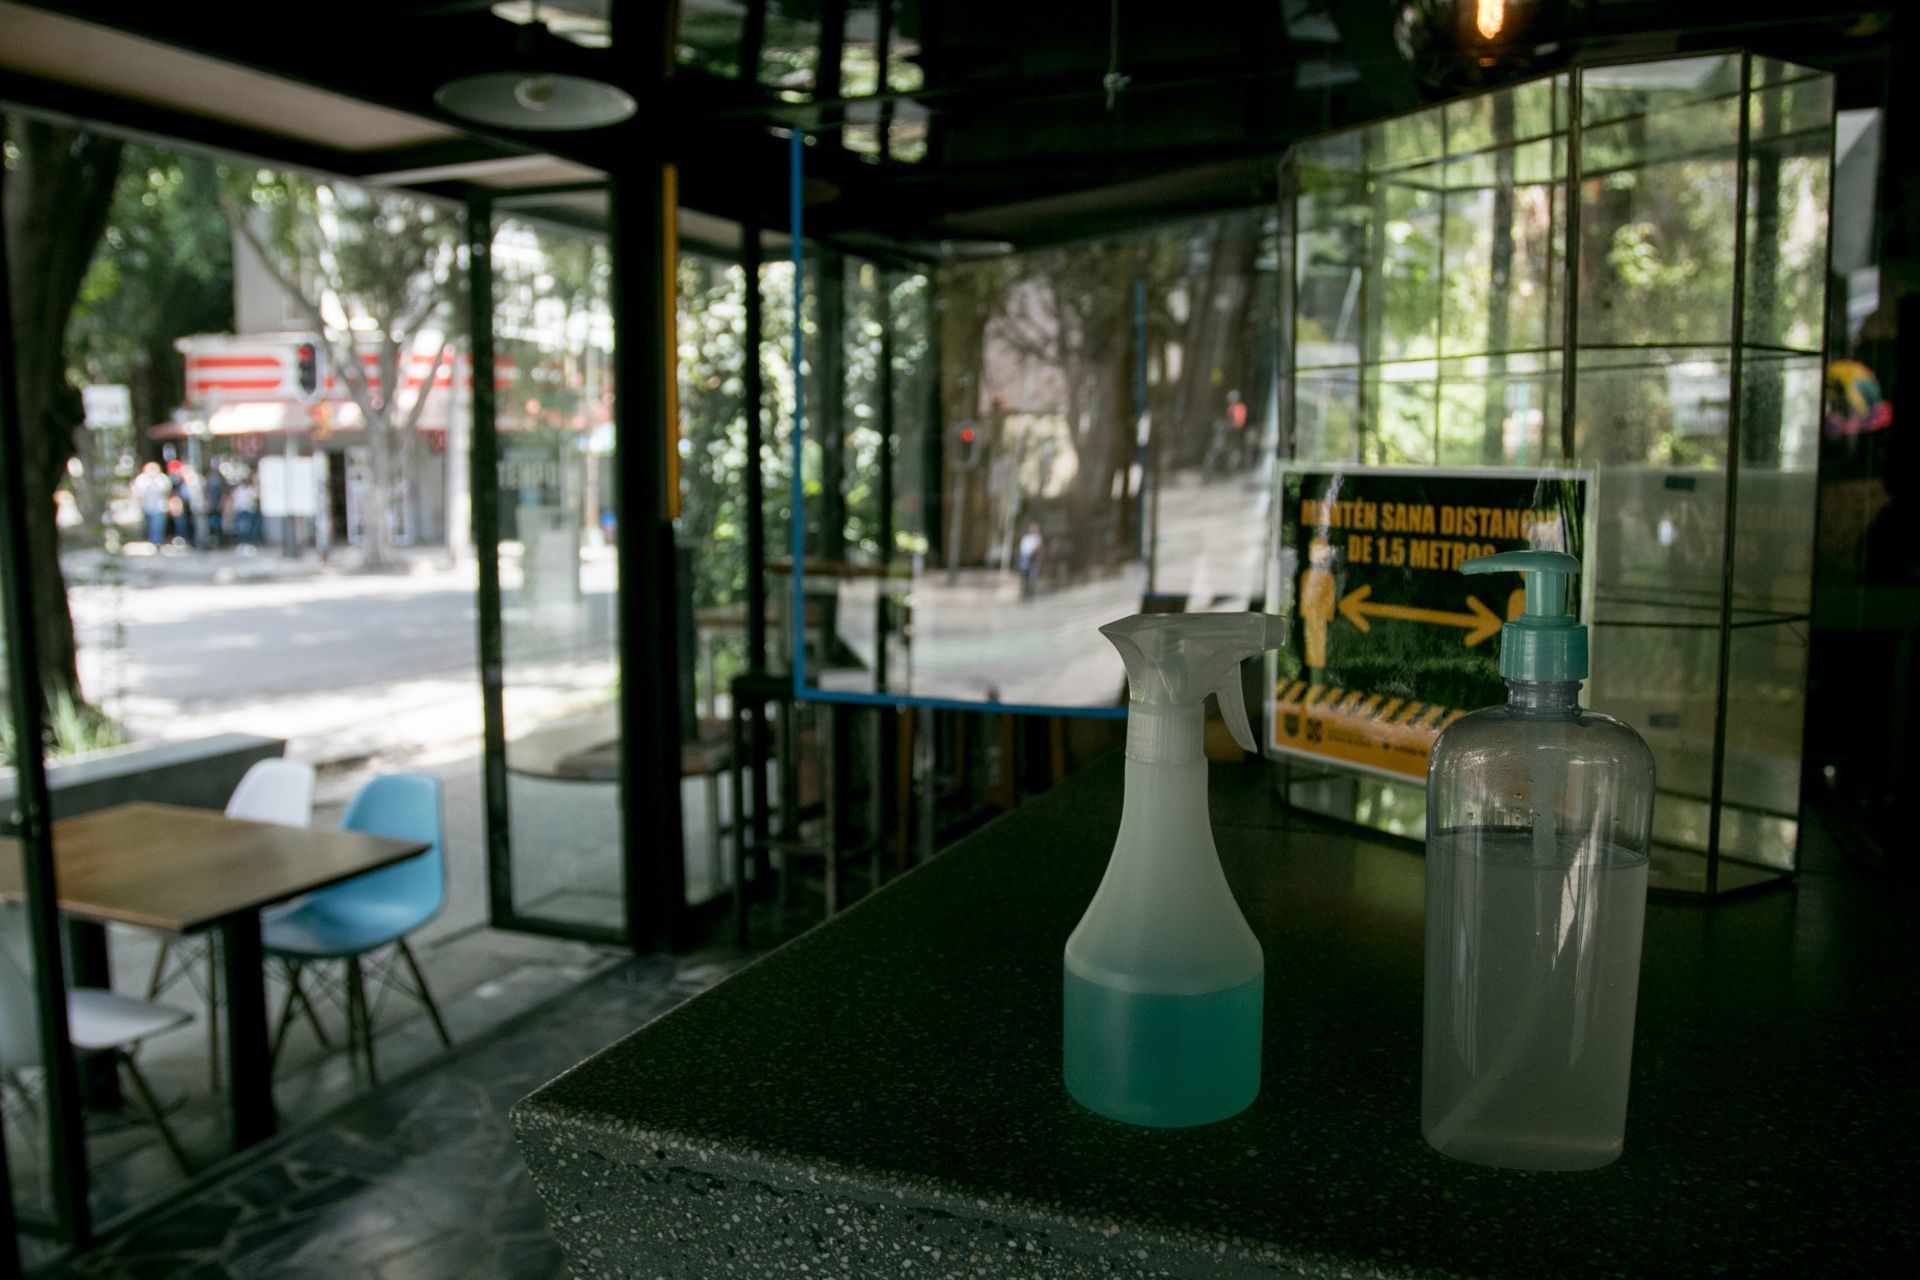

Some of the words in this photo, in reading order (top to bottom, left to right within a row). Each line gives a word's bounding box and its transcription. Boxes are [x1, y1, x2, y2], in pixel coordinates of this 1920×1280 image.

[1381, 502, 1435, 533] SANA
[1347, 535, 1372, 563] DE
[1377, 537, 1405, 566] 1.5
